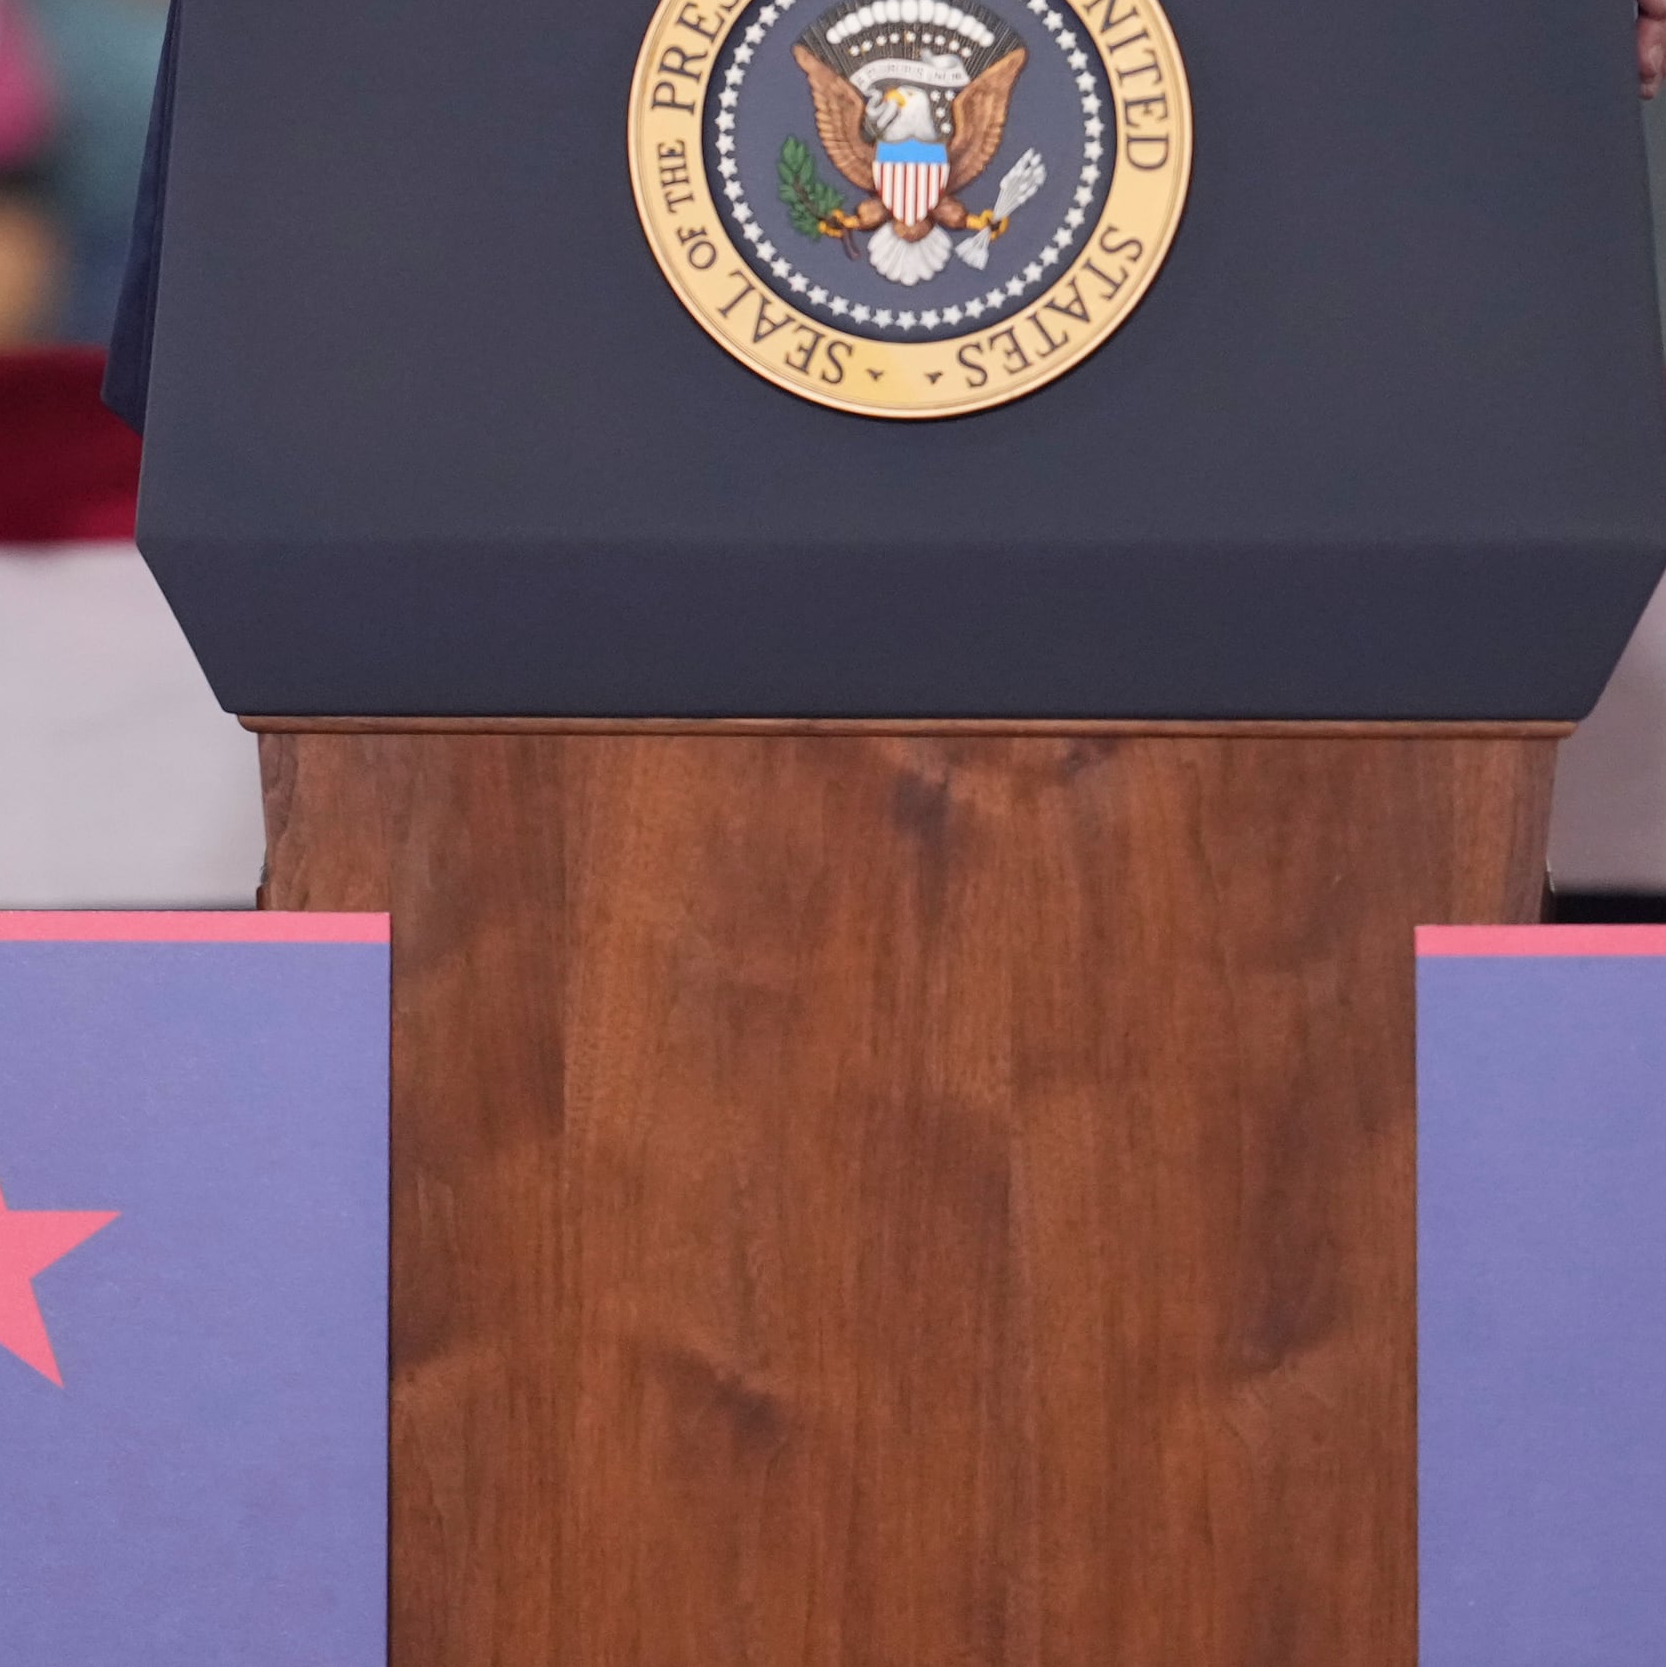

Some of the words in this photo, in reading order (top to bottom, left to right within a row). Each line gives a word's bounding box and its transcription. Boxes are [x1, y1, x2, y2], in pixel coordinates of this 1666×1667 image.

[657, 139, 695, 214] THE
[676, 226, 717, 270] OF
[717, 270, 854, 385] SEAL
[957, 226, 1144, 389] STATES
